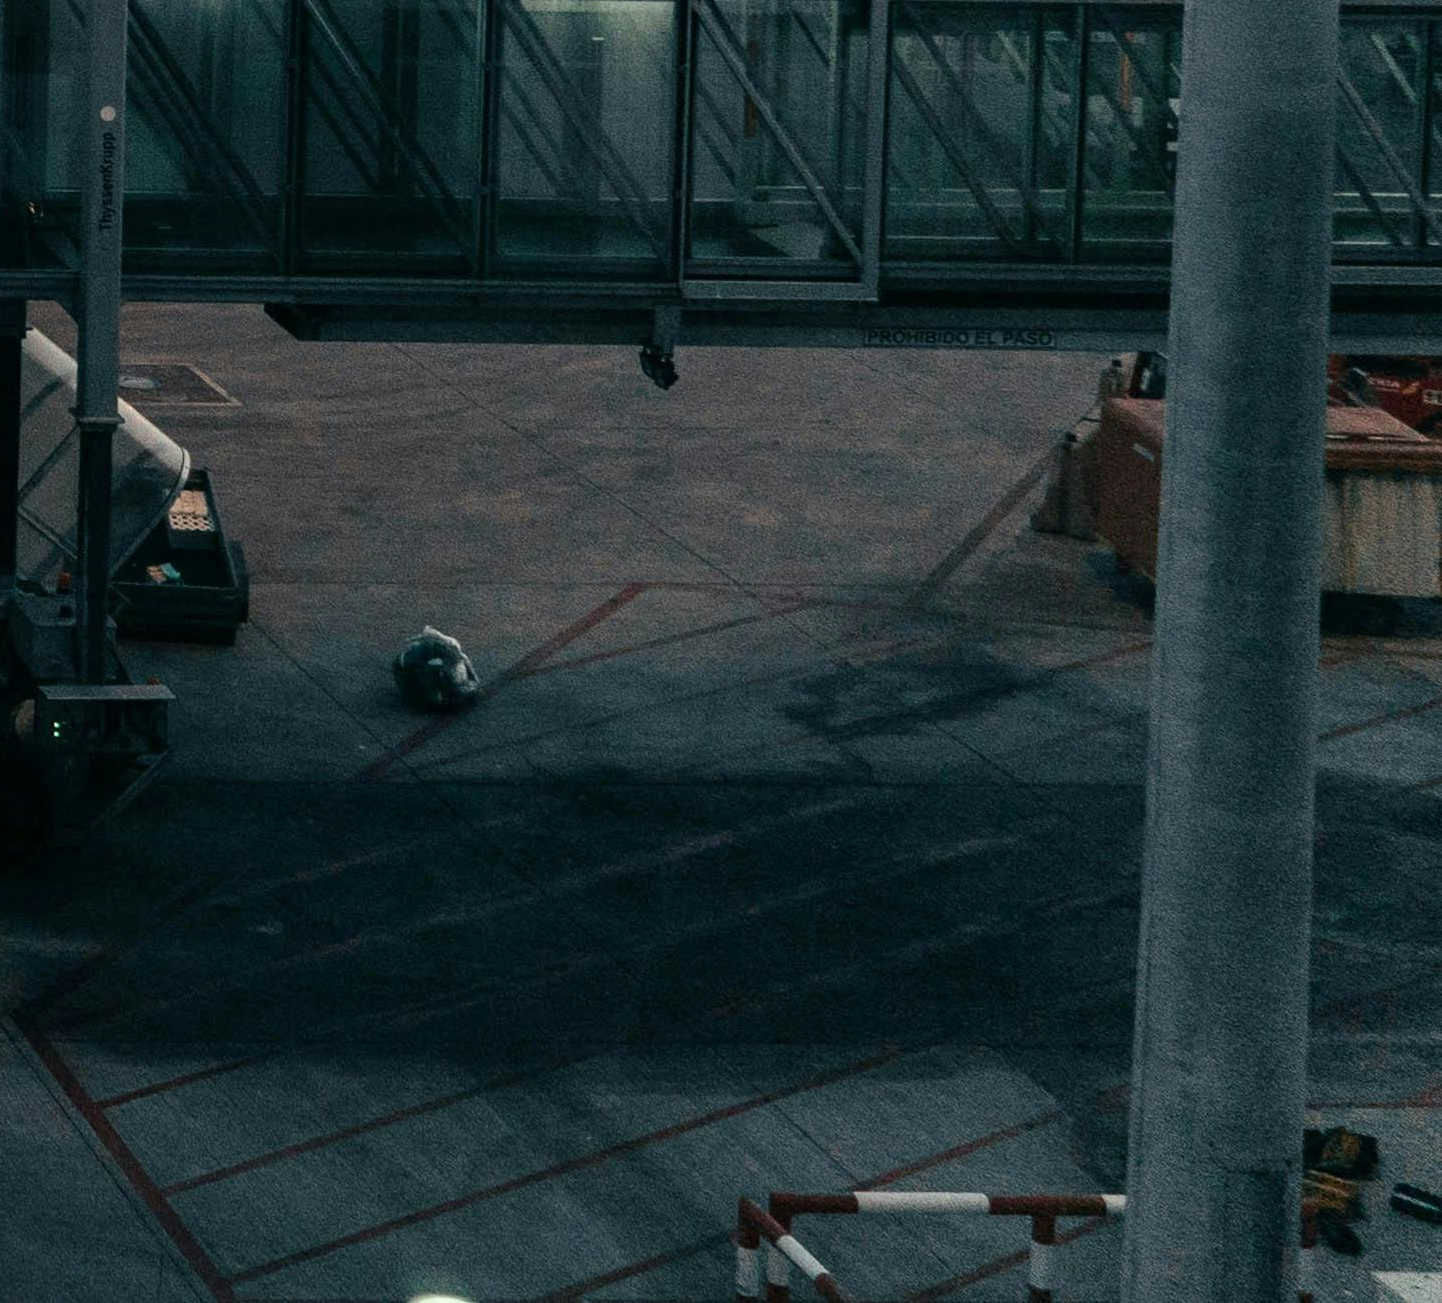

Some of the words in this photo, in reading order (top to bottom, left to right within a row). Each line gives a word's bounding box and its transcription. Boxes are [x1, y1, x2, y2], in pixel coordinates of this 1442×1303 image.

[868, 329, 970, 343] PROHIBIDO
[975, 331, 995, 344] EL
[1002, 331, 1053, 345] PASO
